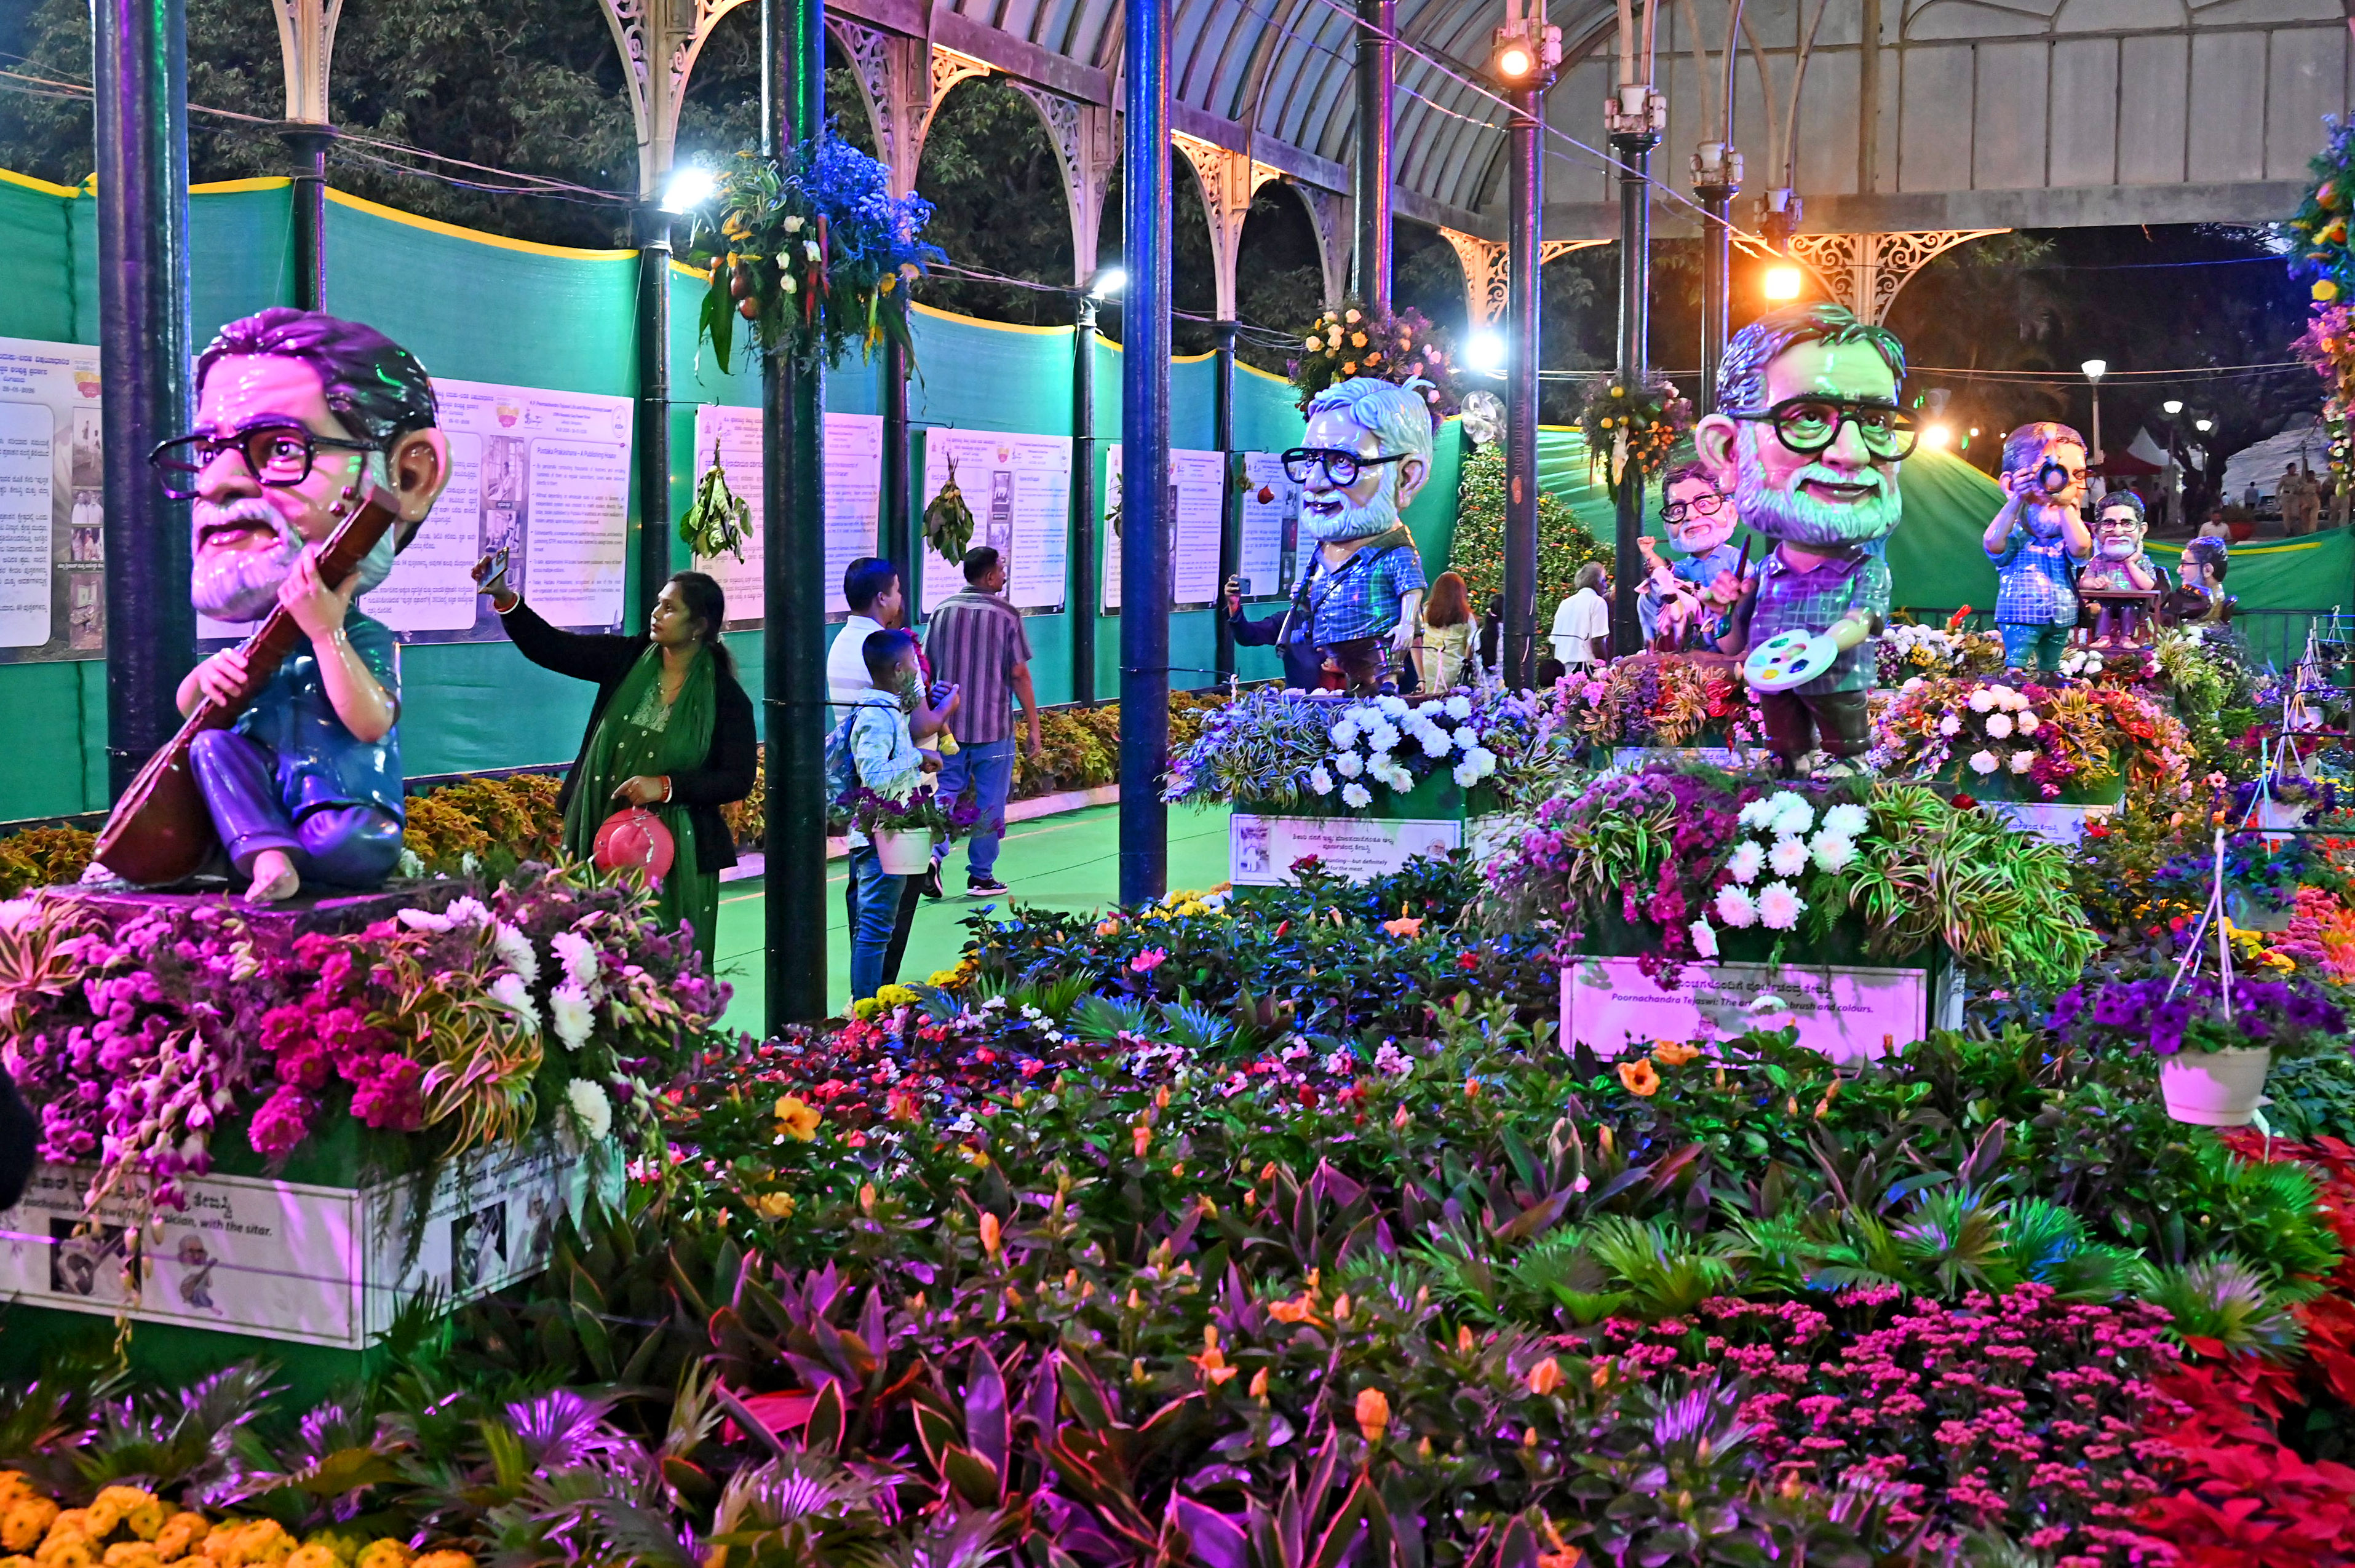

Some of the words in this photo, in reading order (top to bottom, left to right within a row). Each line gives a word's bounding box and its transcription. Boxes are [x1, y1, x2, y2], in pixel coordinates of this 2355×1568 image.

[1677, 980, 1743, 990] ಂಚಗಳೊಂದಿಗೆ
[1612, 993, 1681, 1004] Poornachandra
[1684, 996, 1719, 1006] Tejaswi:
[1721, 997, 1737, 1007] The
[1790, 1002, 1816, 1010] brush
[1837, 1003, 1874, 1013] colours.
[193, 1192, 232, 1219] ತೇಜಸ್ವಿ
[148, 1213, 197, 1227] msician,
[201, 1219, 223, 1230] with
[226, 1221, 242, 1232] the
[245, 1224, 273, 1237] sitar.
